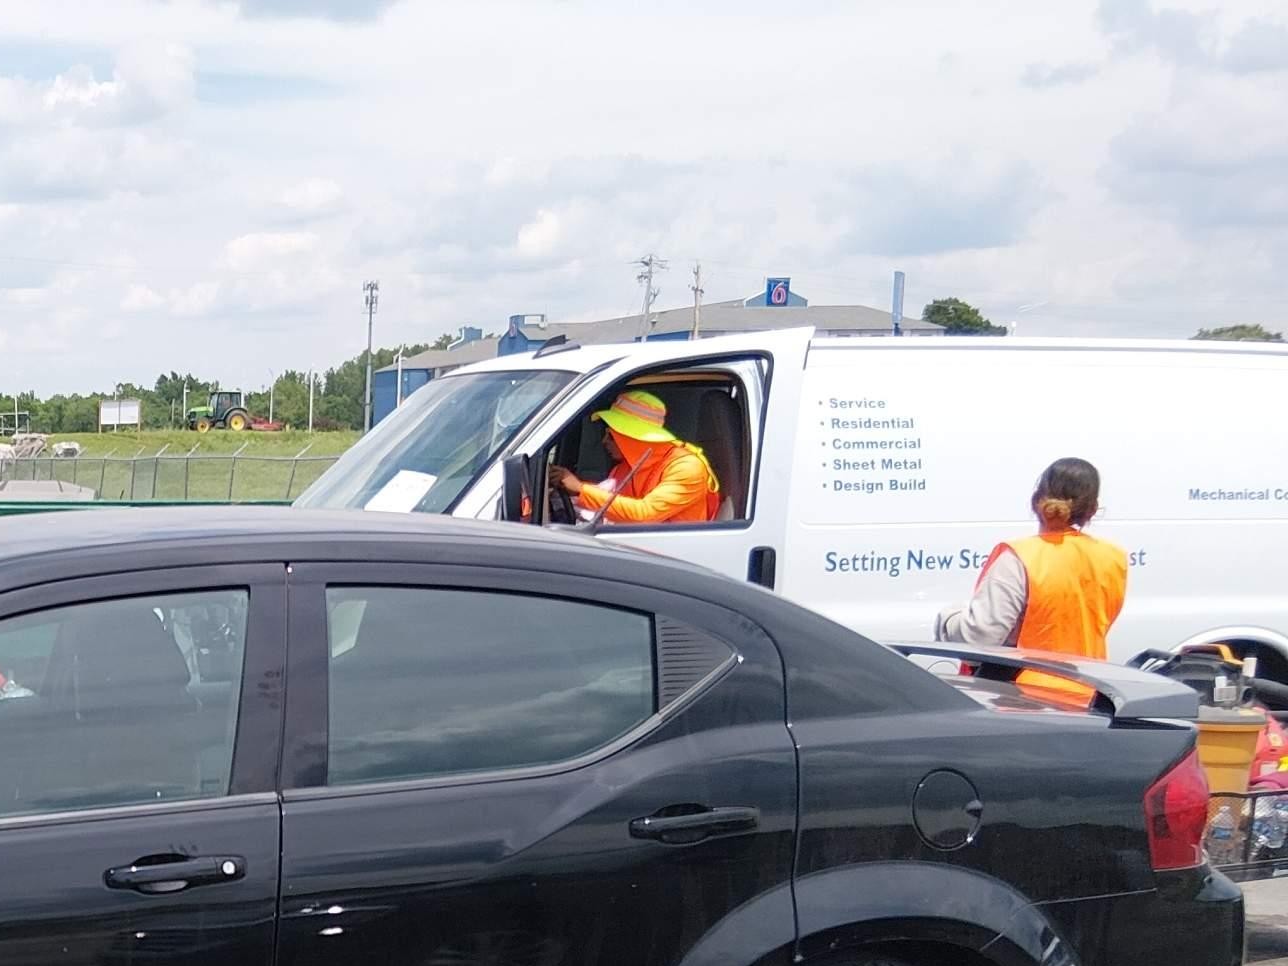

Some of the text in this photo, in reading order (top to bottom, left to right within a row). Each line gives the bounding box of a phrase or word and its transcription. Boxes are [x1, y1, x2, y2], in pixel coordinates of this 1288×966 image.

[771, 281, 787, 304] 6
[829, 397, 886, 409] Service
[831, 417, 914, 429] Residential
[832, 437, 921, 450] Commercial
[833, 458, 922, 470] Sheet Metal
[833, 478, 926, 494] Design Build
[1188, 488, 1270, 501] Mechanical
[825, 550, 900, 577] Setting
[907, 549, 953, 570] New
